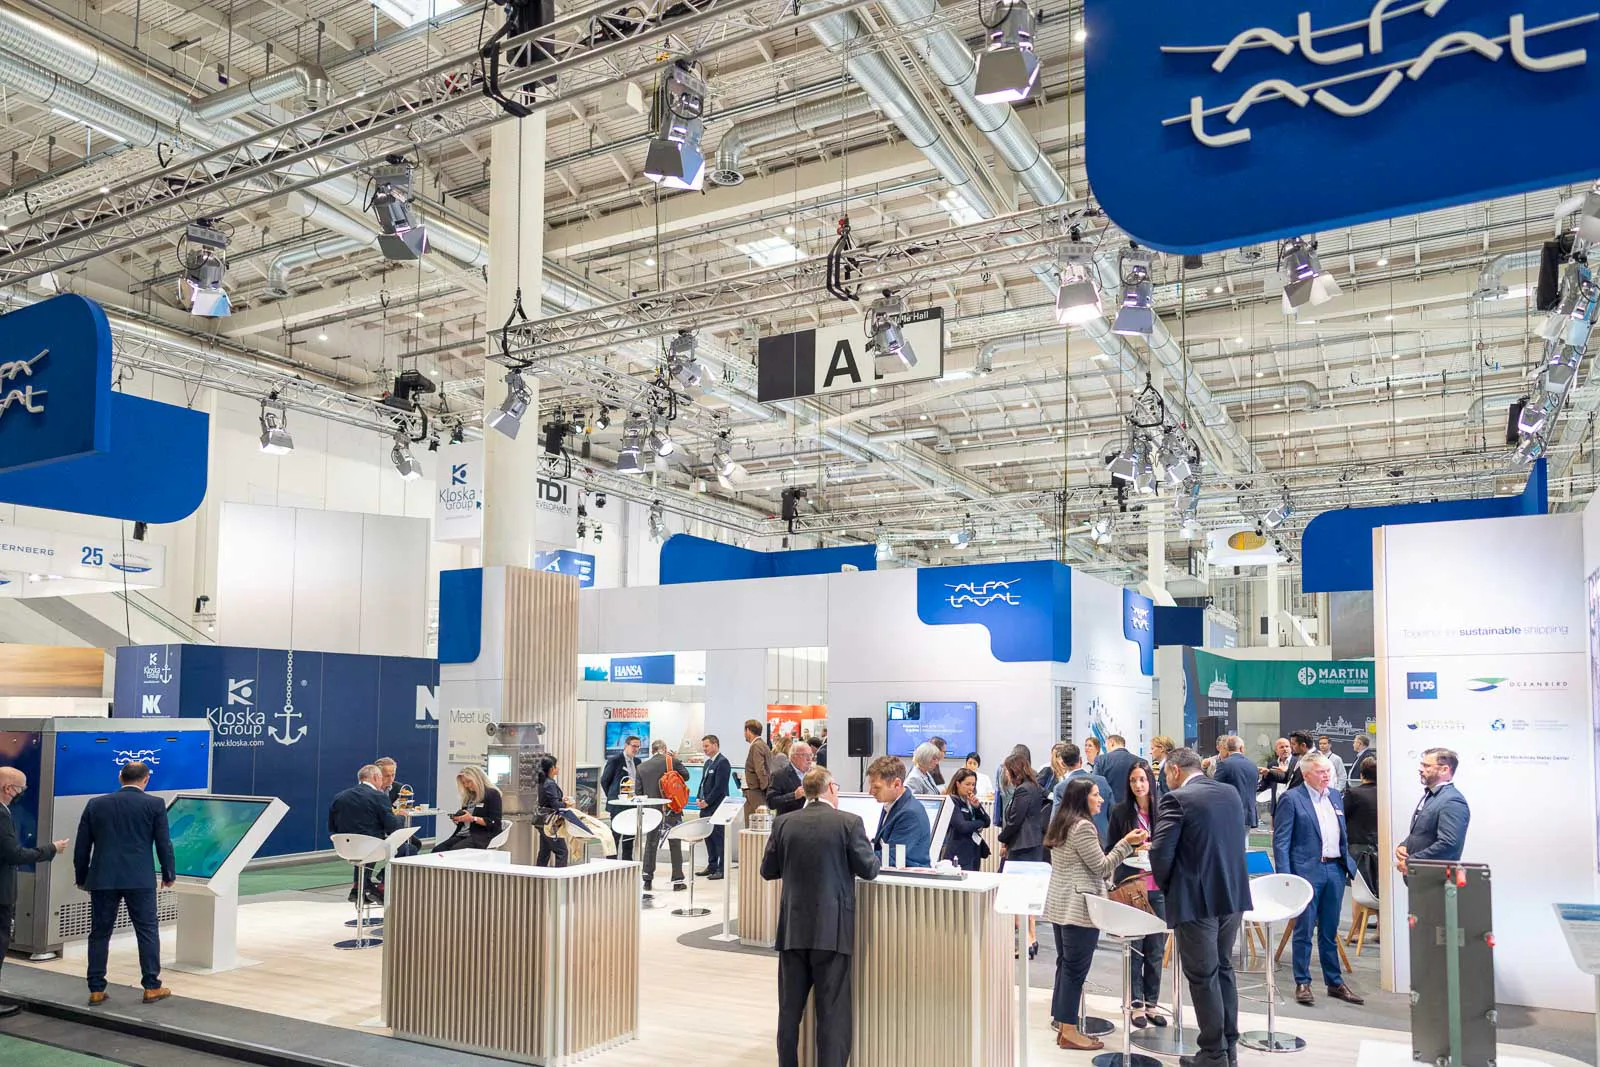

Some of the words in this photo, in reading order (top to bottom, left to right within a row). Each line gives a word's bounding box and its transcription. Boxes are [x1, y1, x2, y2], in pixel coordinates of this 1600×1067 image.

[1161, 0, 1450, 73] ALF
[1162, 13, 1599, 147] LAVAL
[913, 310, 929, 320] Hall
[439, 487, 476, 503] Kloska
[445, 500, 473, 512] Group
[536, 500, 573, 515] EVELOPMENT
[0, 543, 54, 556] ERNBERG
[81, 546, 104, 566] 25
[944, 578, 1022, 594] ALFA
[945, 592, 1022, 608] LAVAL
[1459, 625, 1522, 637] sustainable
[1524, 624, 1569, 636] shipping
[614, 665, 643, 677] HANSA
[1318, 668, 1369, 679] MARTIN
[141, 694, 162, 714] NK
[206, 706, 266, 725] Kloska
[449, 709, 476, 724] Meet
[479, 712, 491, 724] us
[612, 707, 649, 719] MACGREGOR
[217, 723, 262, 738] Group
[112, 749, 162, 758] ALFA
